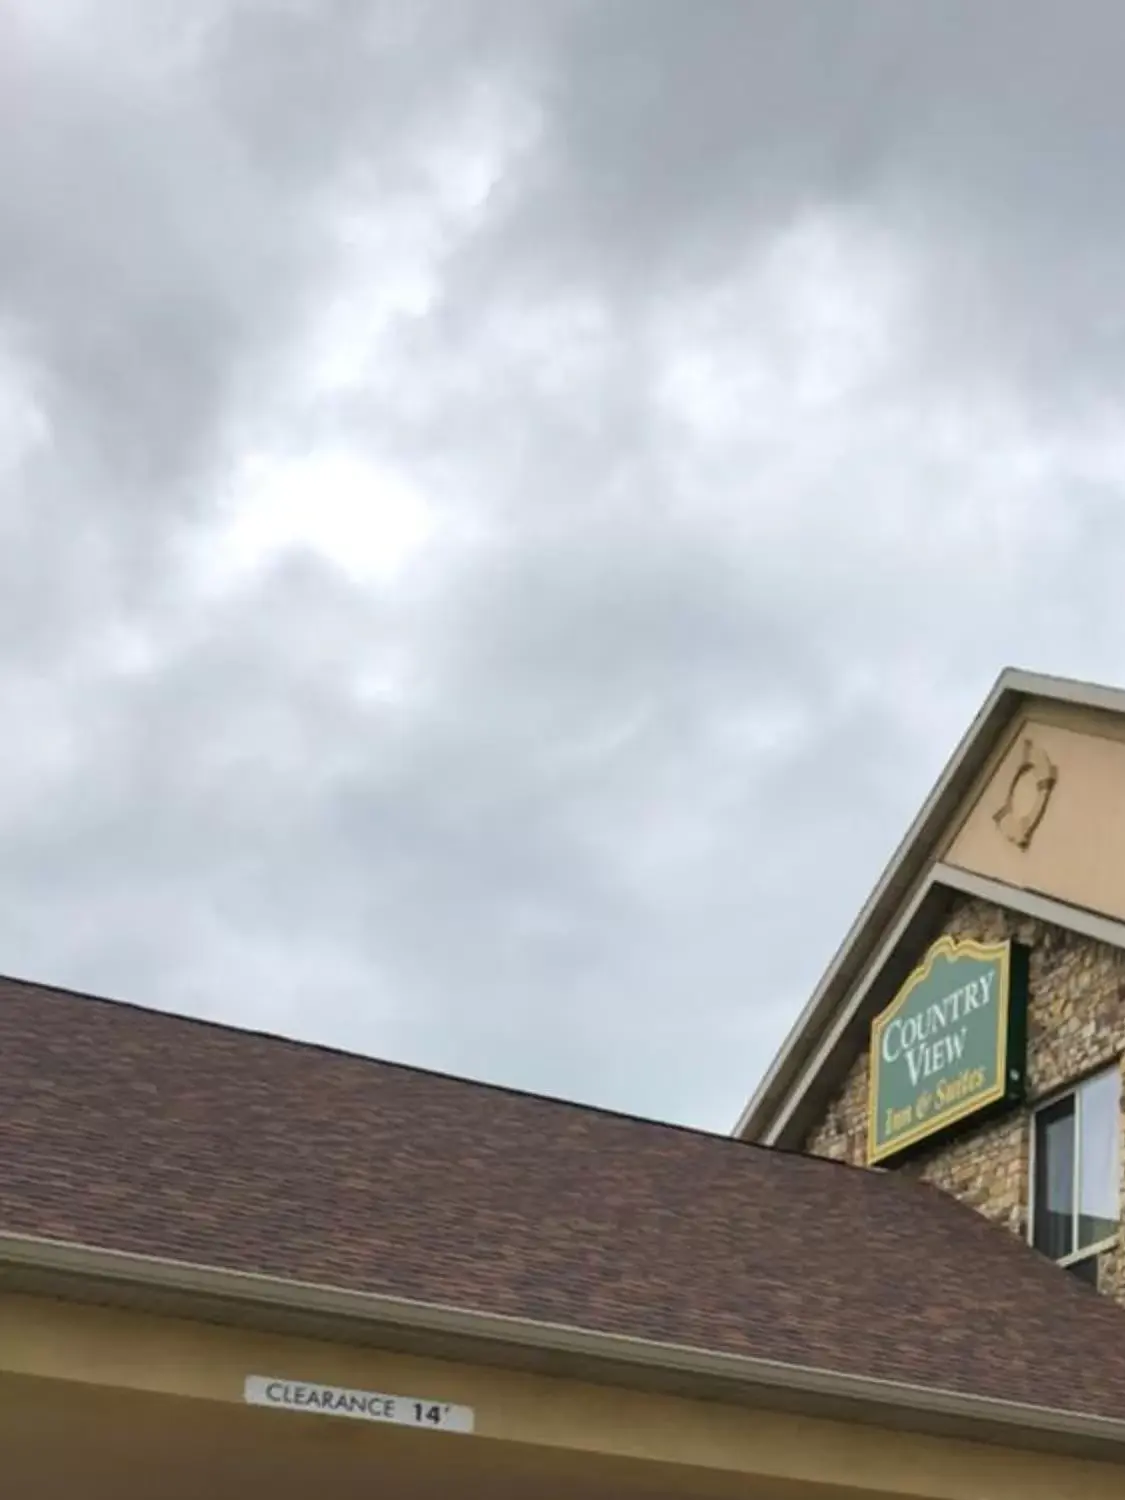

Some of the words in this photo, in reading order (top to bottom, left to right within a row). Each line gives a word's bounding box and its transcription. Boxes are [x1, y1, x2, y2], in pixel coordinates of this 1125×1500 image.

[883, 970, 995, 1062] COUNTRY
[904, 1027, 967, 1086] VIEW
[265, 1382, 396, 1419] CLEARANCE
